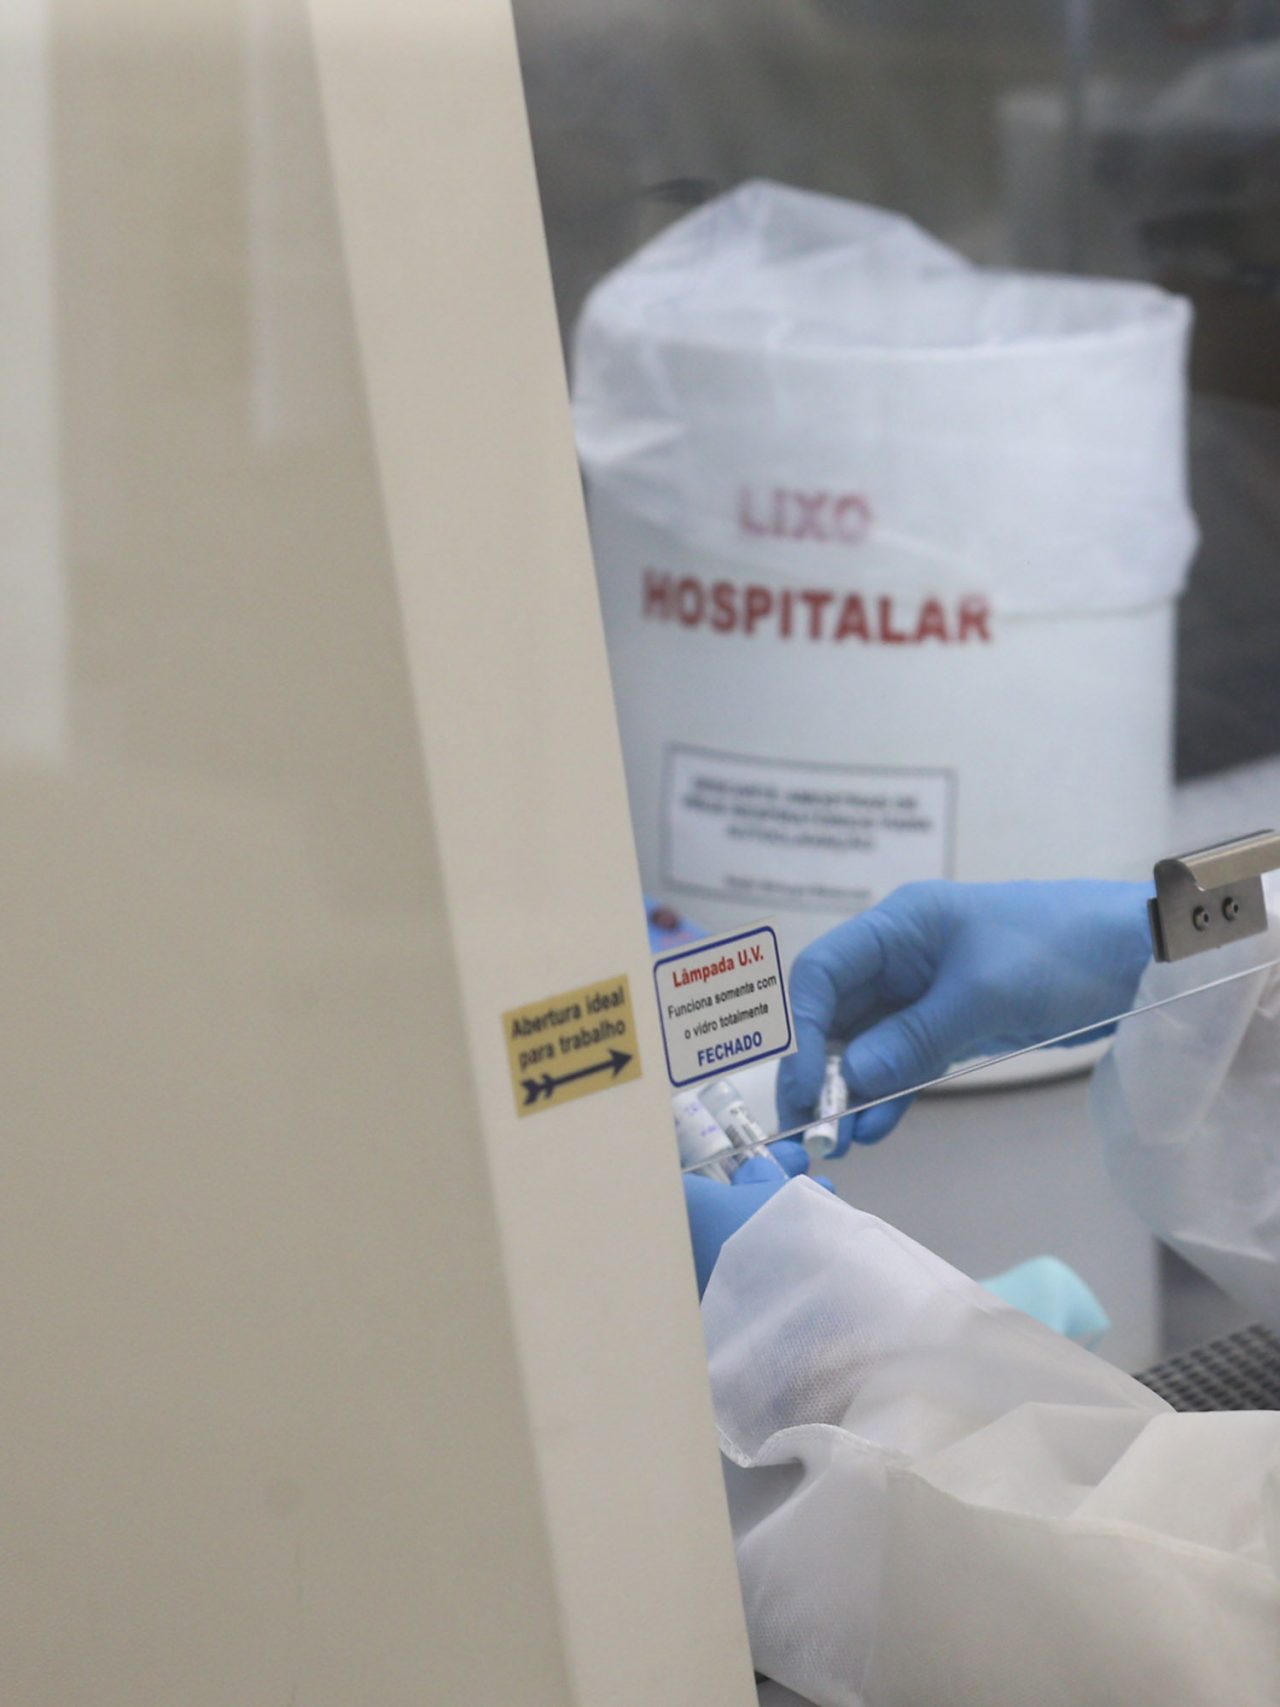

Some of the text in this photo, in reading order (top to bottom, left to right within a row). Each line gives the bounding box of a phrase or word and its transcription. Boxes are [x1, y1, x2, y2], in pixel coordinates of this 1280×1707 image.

[738, 486, 873, 545] LIXO
[642, 566, 993, 646] HOSPITALAR
[672, 944, 764, 988] Lâmpada U.V.
[511, 984, 625, 1040] Abertura ideal
[667, 975, 777, 1019] Funciona somente com
[684, 1003, 769, 1040] o vidro totalmente
[518, 1019, 626, 1073] para trabalho
[697, 1030, 763, 1067] FECHADO
